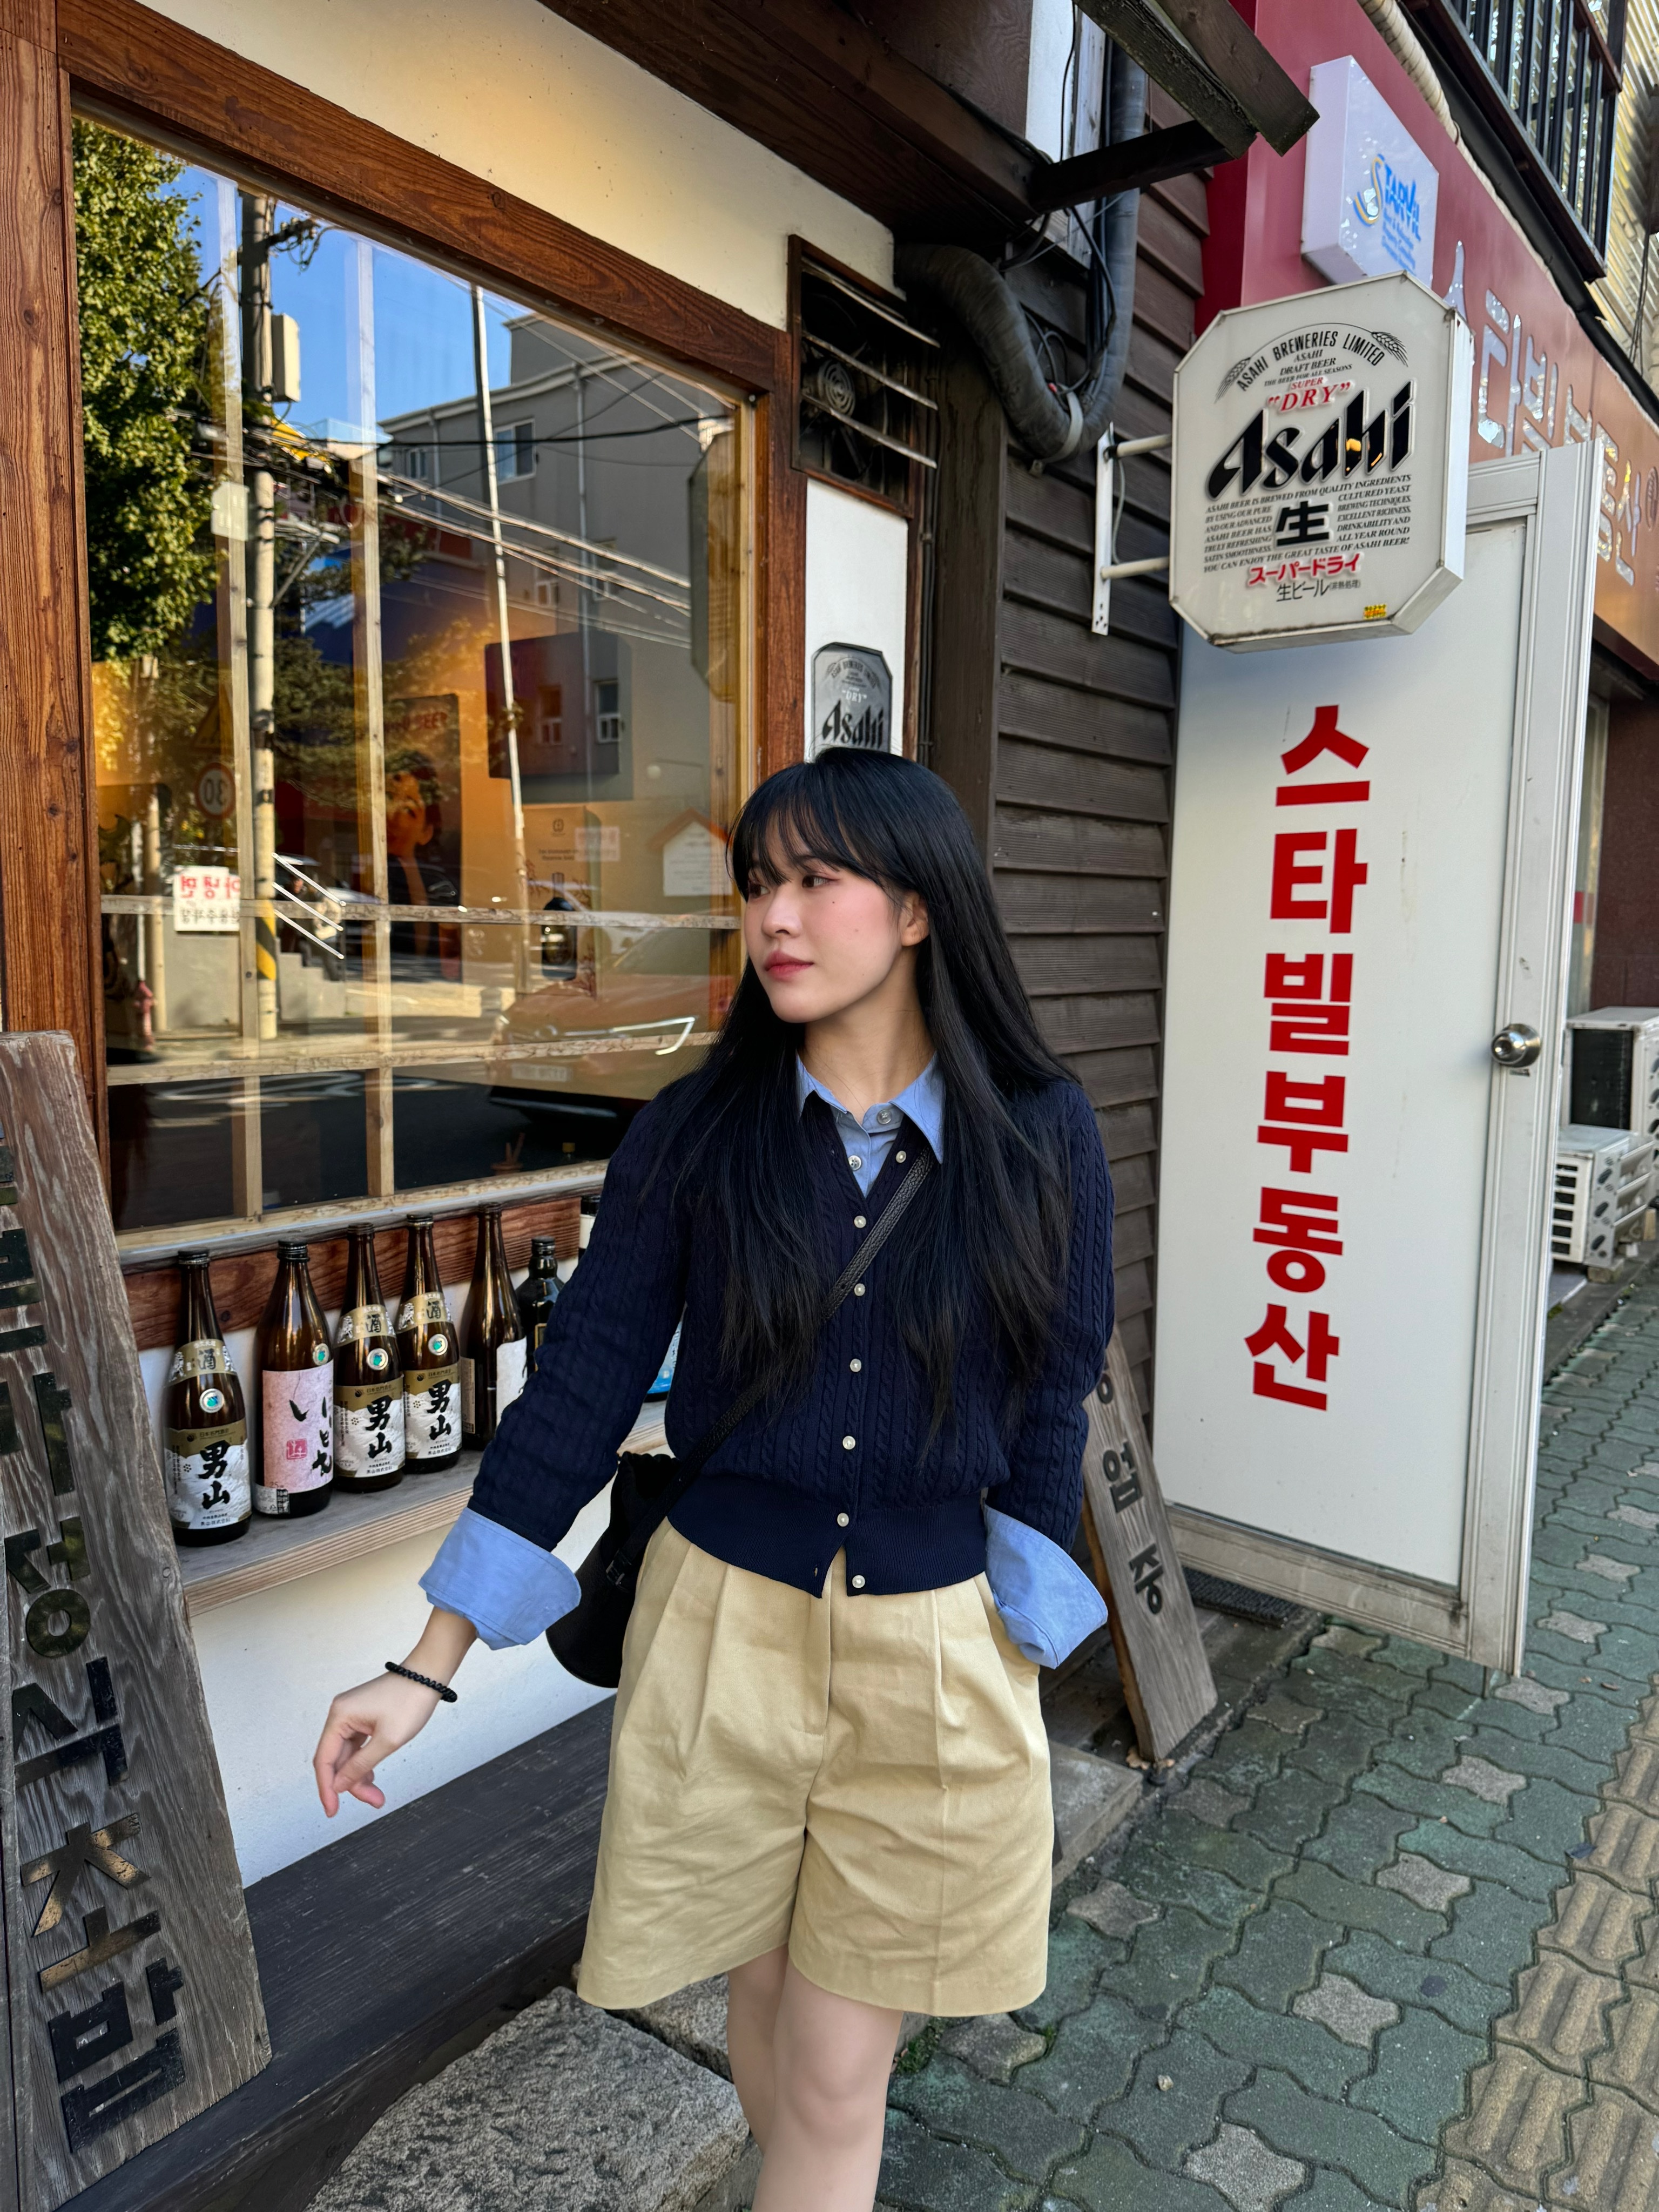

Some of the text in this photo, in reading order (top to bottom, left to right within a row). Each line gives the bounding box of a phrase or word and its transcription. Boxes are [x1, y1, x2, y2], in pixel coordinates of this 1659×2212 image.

[1236, 331, 1385, 392] ASAHI BREWERIES LIMITED
[1280, 358, 1337, 376] DRAFT BEER
[1294, 349, 1323, 362] ASAHI
[1264, 364, 1353, 387] THE BEER FOR ALL SEASONS
[1290, 377, 1324, 390] SUPER
[1208, 380, 1414, 500] Asahi
[1206, 503, 1229, 512] ASAHI
[1230, 500, 1250, 509] BEER
[1260, 493, 1293, 503] BREWED
[1294, 489, 1317, 498] FROM
[1319, 482, 1354, 496] QUALITY
[1355, 475, 1411, 489] INGREDIENTS
[1216, 512, 1236, 522] USING
[1237, 510, 1252, 518] OUR
[1253, 506, 1272, 515] PURE
[1338, 489, 1384, 501] CULTURED
[1385, 485, 1411, 495] YEAST
[1204, 516, 1411, 553] TRULY REFRESHING DRINKABILITY AND
[1205, 525, 1219, 533] AND
[1220, 522, 1235, 530] OUR
[1235, 516, 1272, 527] ADVANCED
[1337, 501, 1368, 511] BREWING
[1205, 533, 1229, 543] ASAHI
[1231, 529, 1252, 539] BEER
[1255, 526, 1272, 535] HAS
[1337, 510, 1375, 522] EXCELLENT
[1276, 501, 1329, 546] 生
[1204, 554, 1223, 563] SATIN
[1336, 534, 1353, 542] ALL
[1353, 530, 1377, 540] YEAR
[1378, 527, 1410, 537] ROUND
[1204, 565, 1219, 573] YOU
[1220, 561, 1238, 570] CAN
[1239, 556, 1265, 567] ENJOY
[1266, 552, 1283, 562] THE
[1284, 548, 1312, 559] GREAT
[1315, 545, 1339, 555] TASTE
[1340, 543, 1353, 552] OF
[1353, 541, 1381, 550] ASAHI
[1249, 553, 1360, 585] スーパードライ
[822, 699, 884, 748] Asahi
[1244, 704, 1370, 1412] 스타빌부동산
[365, 1395, 393, 1459] 男山
[427, 1379, 452, 1440] 男山
[198, 1440, 231, 1509] 男山
